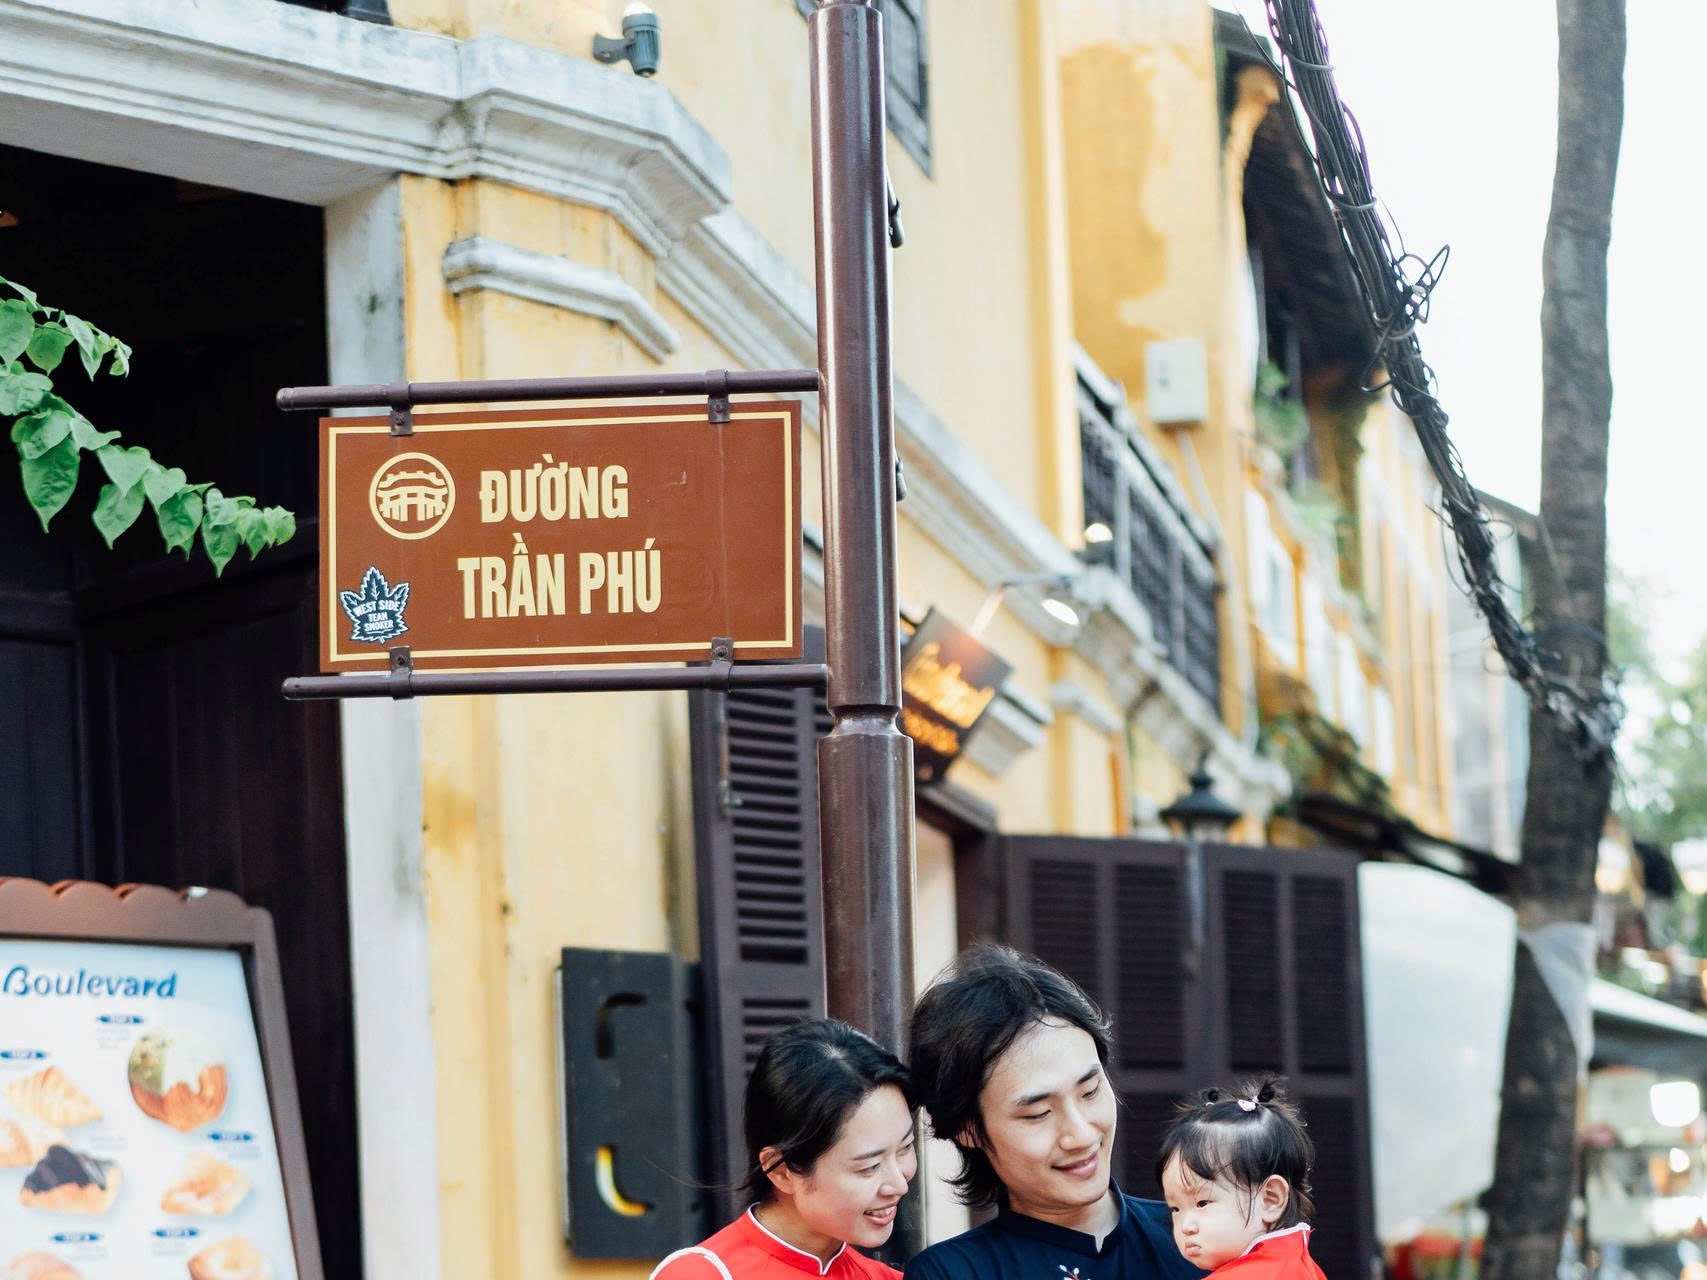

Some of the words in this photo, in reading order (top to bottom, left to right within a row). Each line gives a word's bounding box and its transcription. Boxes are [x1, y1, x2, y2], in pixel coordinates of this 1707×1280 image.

[479, 453, 629, 523] ĐƯỜNG
[457, 532, 566, 619] TRẦN
[579, 537, 662, 615] PHÚ
[353, 601, 377, 617] WEST
[378, 600, 401, 611] SIDE
[363, 620, 394, 631] SMOKER
[3, 965, 177, 997] Boulevard
